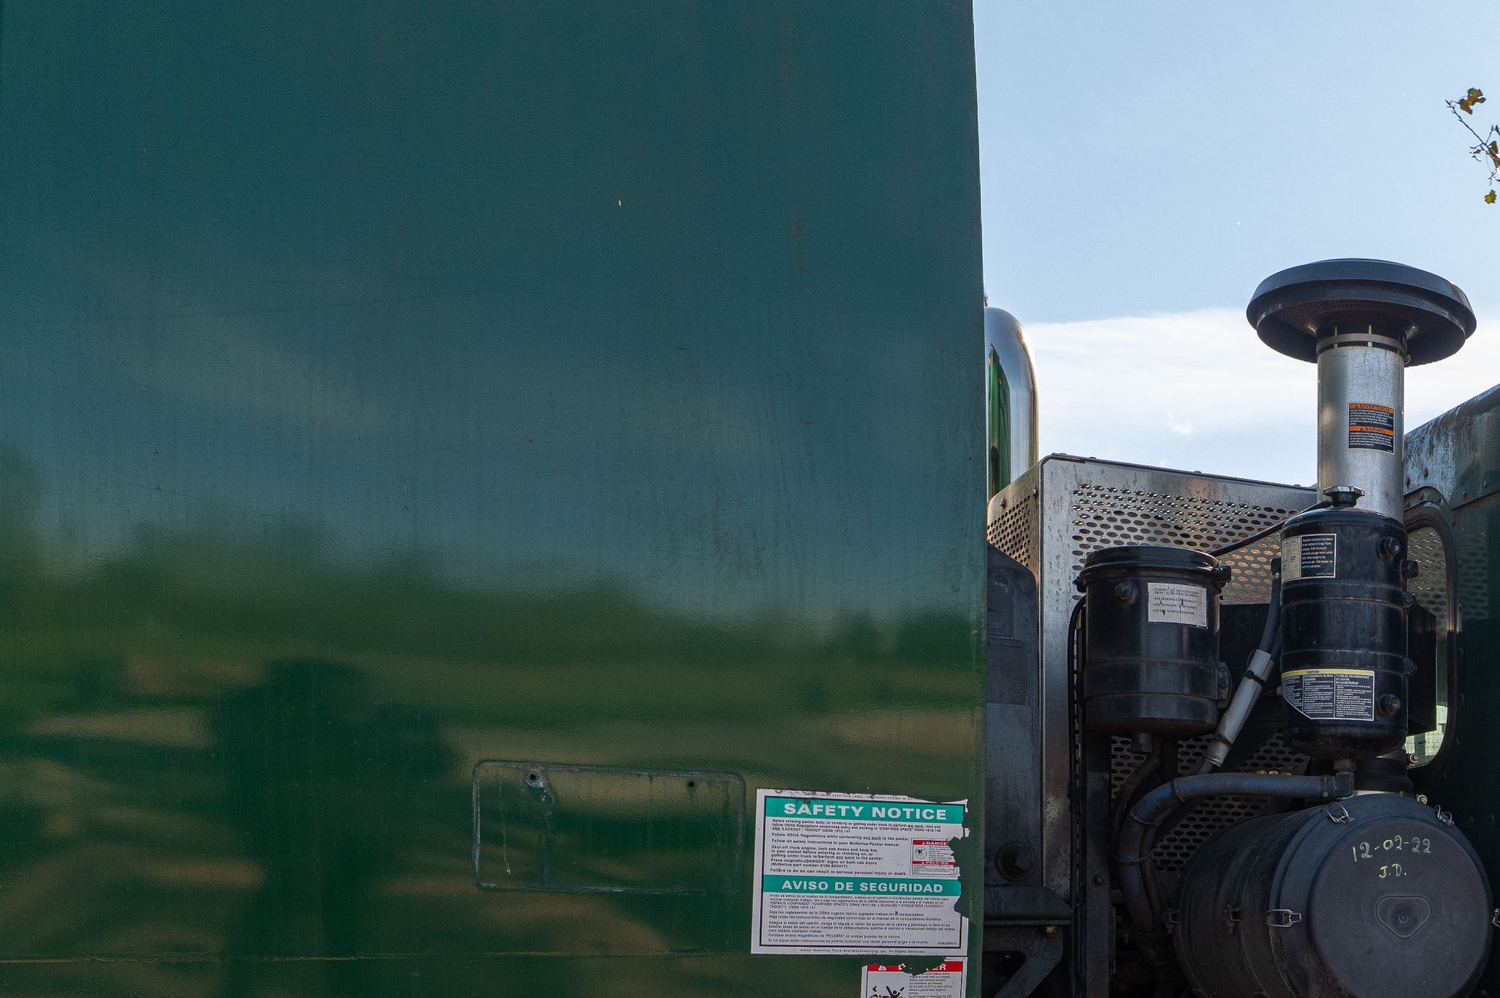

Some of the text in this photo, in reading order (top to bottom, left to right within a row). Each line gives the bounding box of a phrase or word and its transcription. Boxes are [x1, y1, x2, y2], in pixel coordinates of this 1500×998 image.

[784, 803, 947, 820] SAFETY NOTICE
[1352, 834, 1432, 862] 12-02-22
[782, 880, 943, 893] AVISO DE SEGURIDAD
